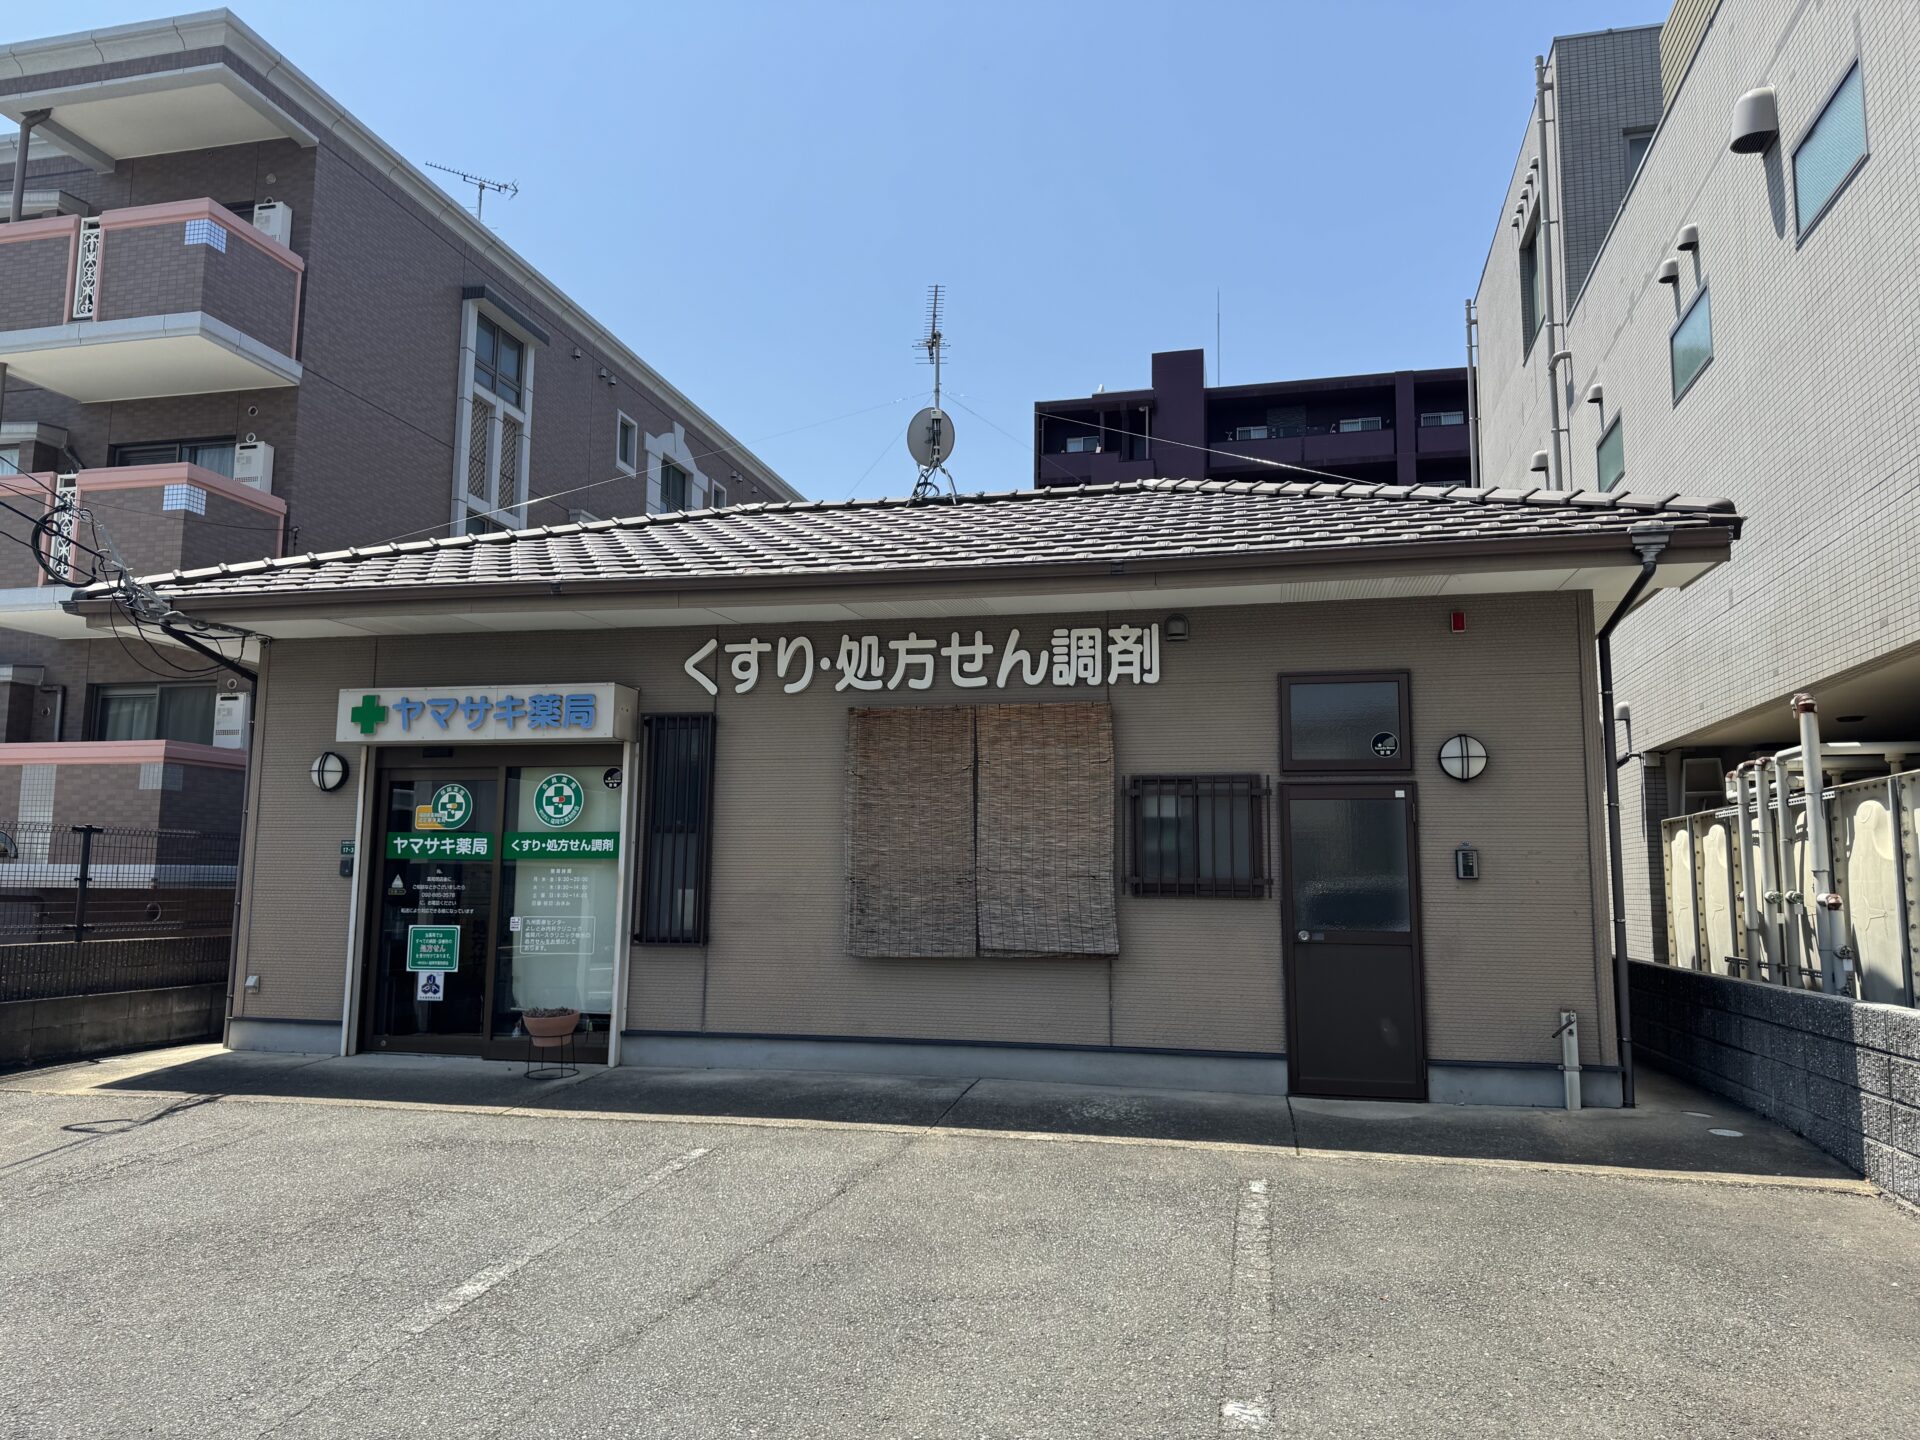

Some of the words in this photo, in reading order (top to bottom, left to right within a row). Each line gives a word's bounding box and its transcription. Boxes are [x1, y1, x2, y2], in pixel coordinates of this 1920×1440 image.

[684, 623, 1161, 695] くすり・処方せん調剤
[392, 694, 597, 731] ヤマサキ薬局
[393, 837, 488, 855] ヤマサキ薬局
[511, 838, 614, 852] くすり・処方せん調剤
